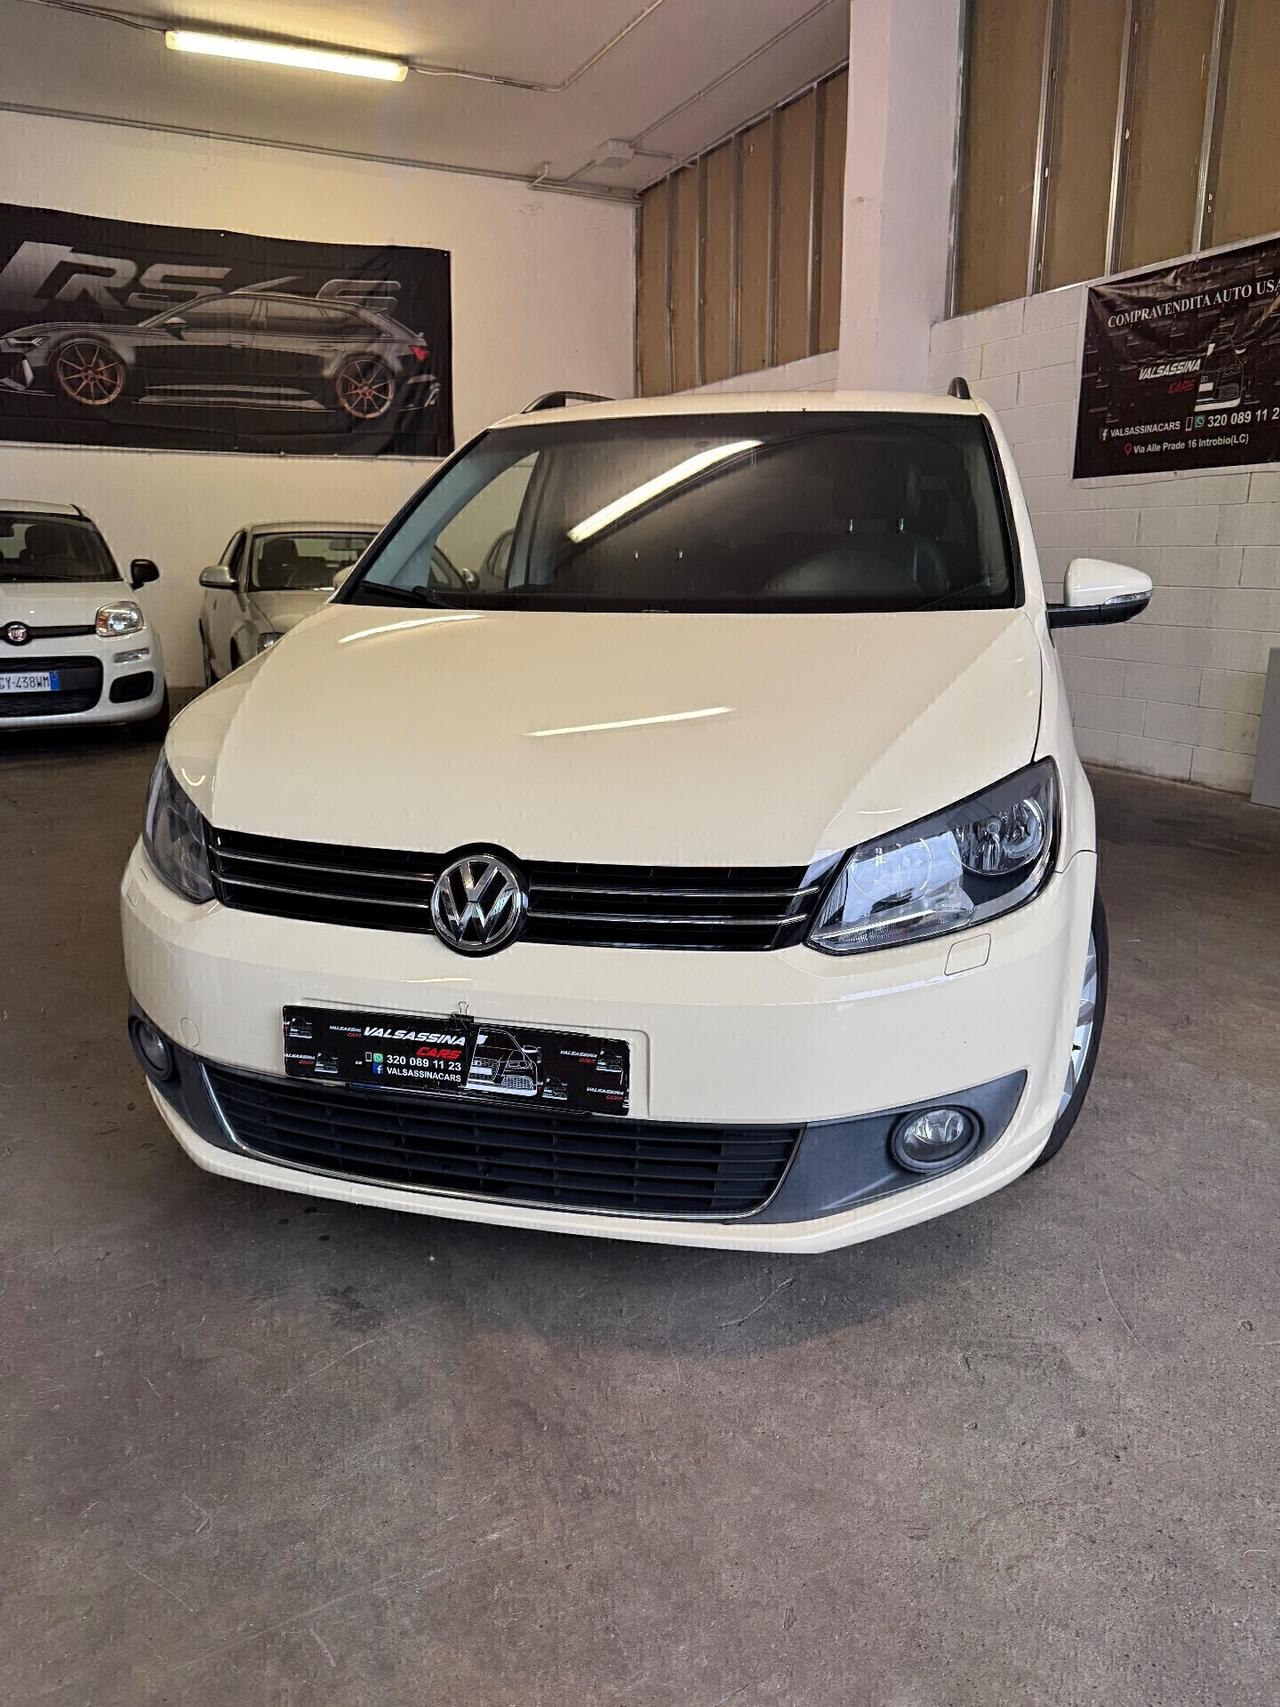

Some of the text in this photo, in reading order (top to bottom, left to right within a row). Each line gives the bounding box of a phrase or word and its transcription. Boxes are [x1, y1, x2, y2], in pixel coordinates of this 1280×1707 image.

[1108, 294, 1211, 328] COMPRAVENDITA
[1213, 284, 1253, 305] AUTO
[1138, 359, 1201, 380] VALSASSINA
[1168, 380, 1196, 394] CARS
[1110, 421, 1181, 437] VALSASSINACARS
[1207, 414, 1228, 427] 320
[1231, 410, 1252, 425] 089
[1256, 408, 1268, 421] 11
[1271, 407, 1280, 420] 2
[1133, 433, 1249, 454] Via Alle Prade 16 Introbio(LC)
[363, 1026, 466, 1046] VALSASSINA
[386, 1054, 462, 1071] 320 089 11 23
[416, 1046, 462, 1059] CARS
[386, 1066, 462, 1082] VALSASSINACARS
